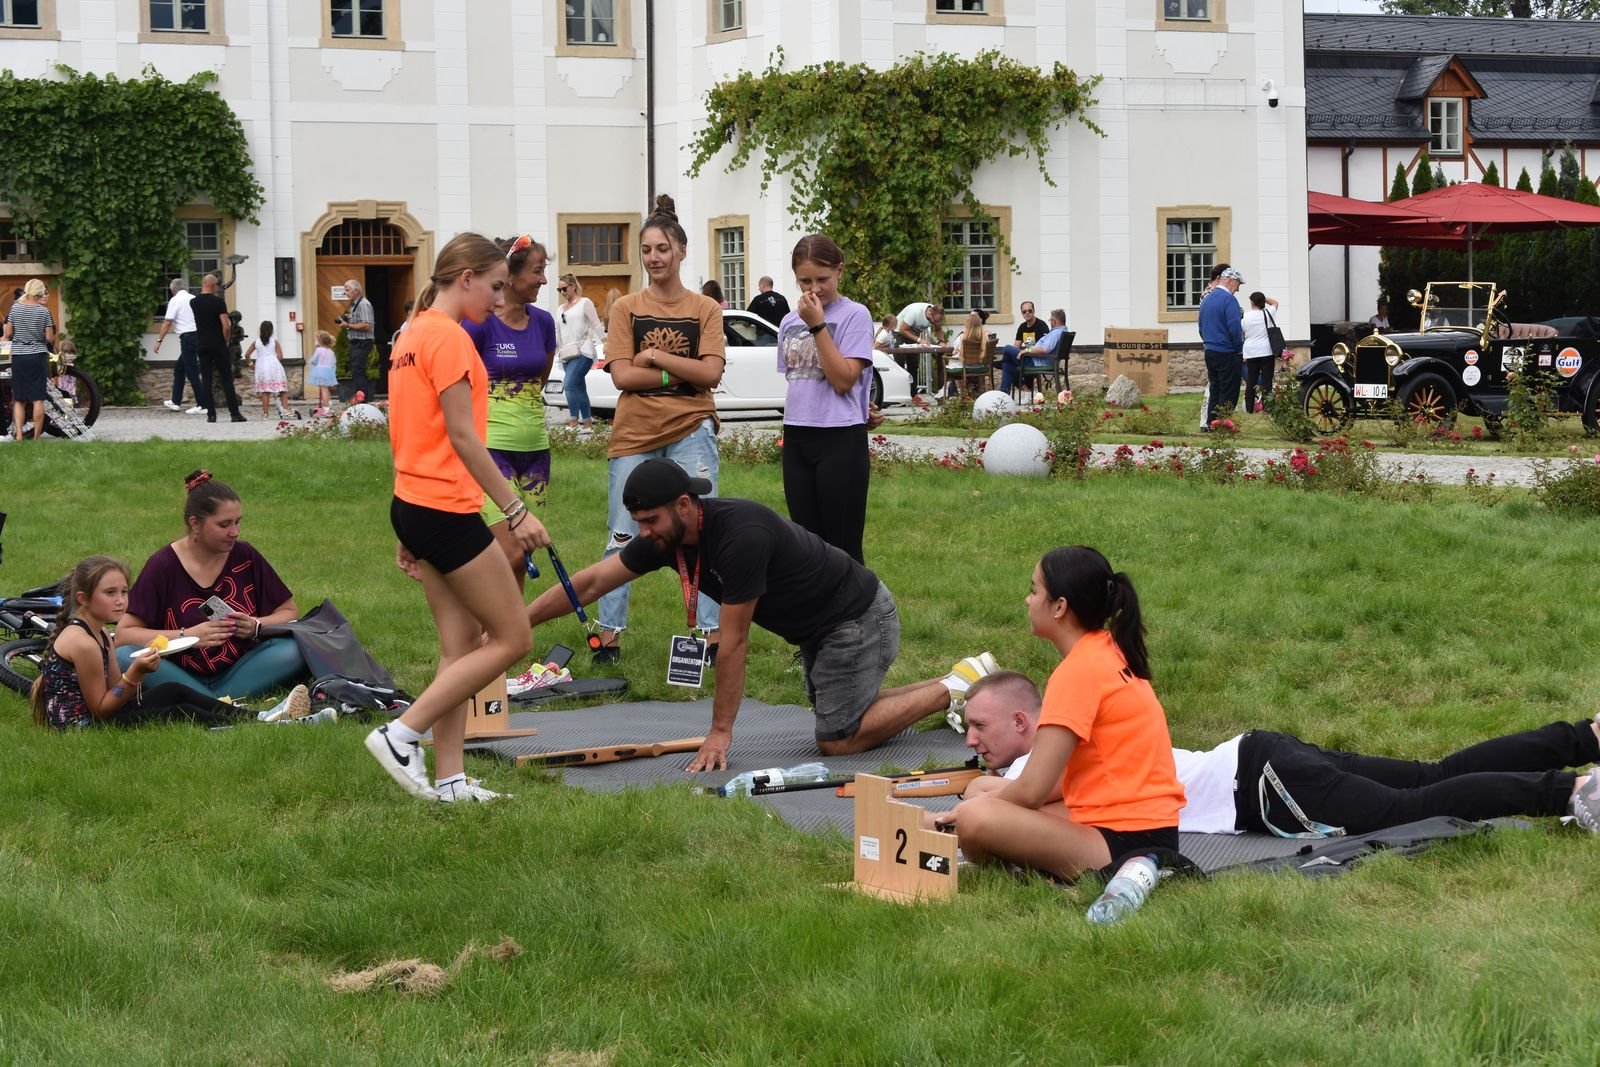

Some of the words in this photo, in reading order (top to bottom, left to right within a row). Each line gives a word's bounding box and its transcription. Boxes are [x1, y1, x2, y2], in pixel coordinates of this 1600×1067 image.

[1116, 341, 1164, 349] Lounge-Set
[1558, 357, 1580, 367] Gulf
[1355, 385, 1367, 396] WL
[672, 656, 702, 666] ORGANIZATOR
[895, 828, 908, 865] 2
[926, 855, 944, 872] 4F
